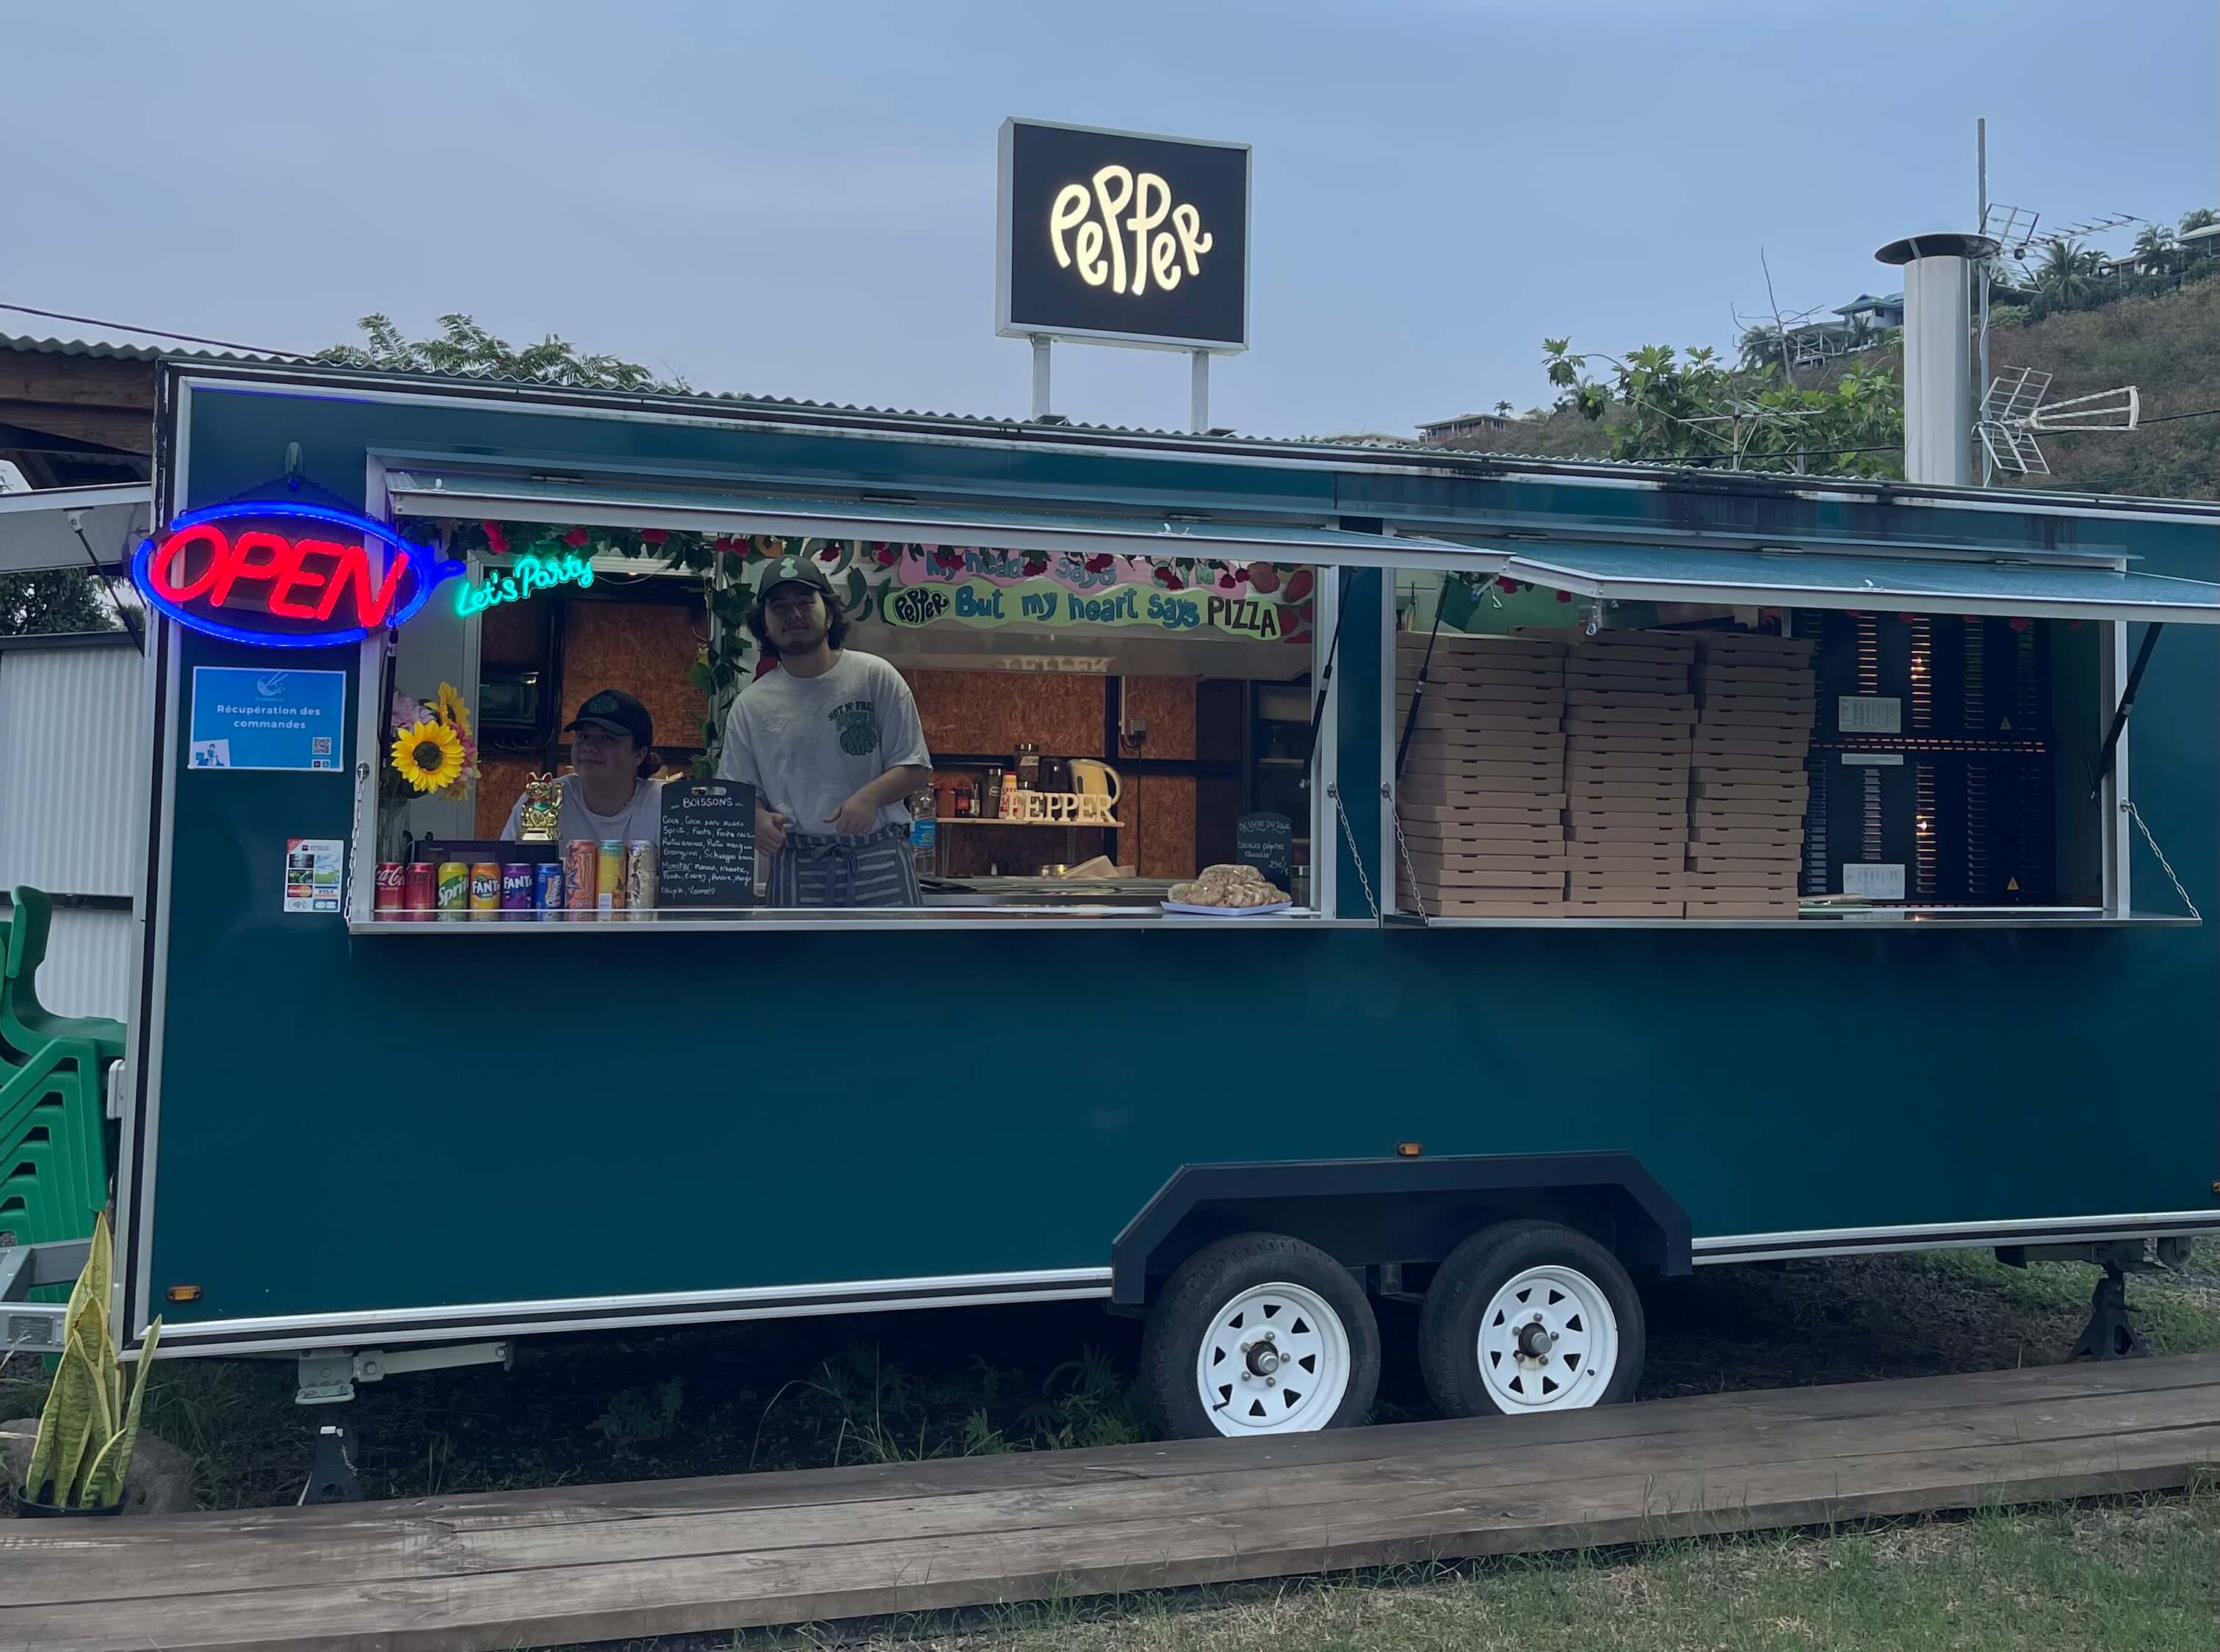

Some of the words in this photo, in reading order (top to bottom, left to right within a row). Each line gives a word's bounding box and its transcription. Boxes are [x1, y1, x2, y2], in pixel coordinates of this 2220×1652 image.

[151, 524, 409, 628] OPEN
[457, 570, 518, 617] Let's
[513, 555, 593, 597] Party
[955, 586, 1005, 619] But
[1022, 592, 1057, 621] my
[1069, 587, 1138, 622] heart
[1147, 593, 1201, 630] says
[1208, 595, 1276, 637] PIZZA
[217, 705, 297, 716] Récupération
[300, 706, 321, 716] des
[234, 720, 305, 729] commandes
[683, 797, 733, 807] BOISSONS
[1005, 790, 1117, 822] PEPPER
